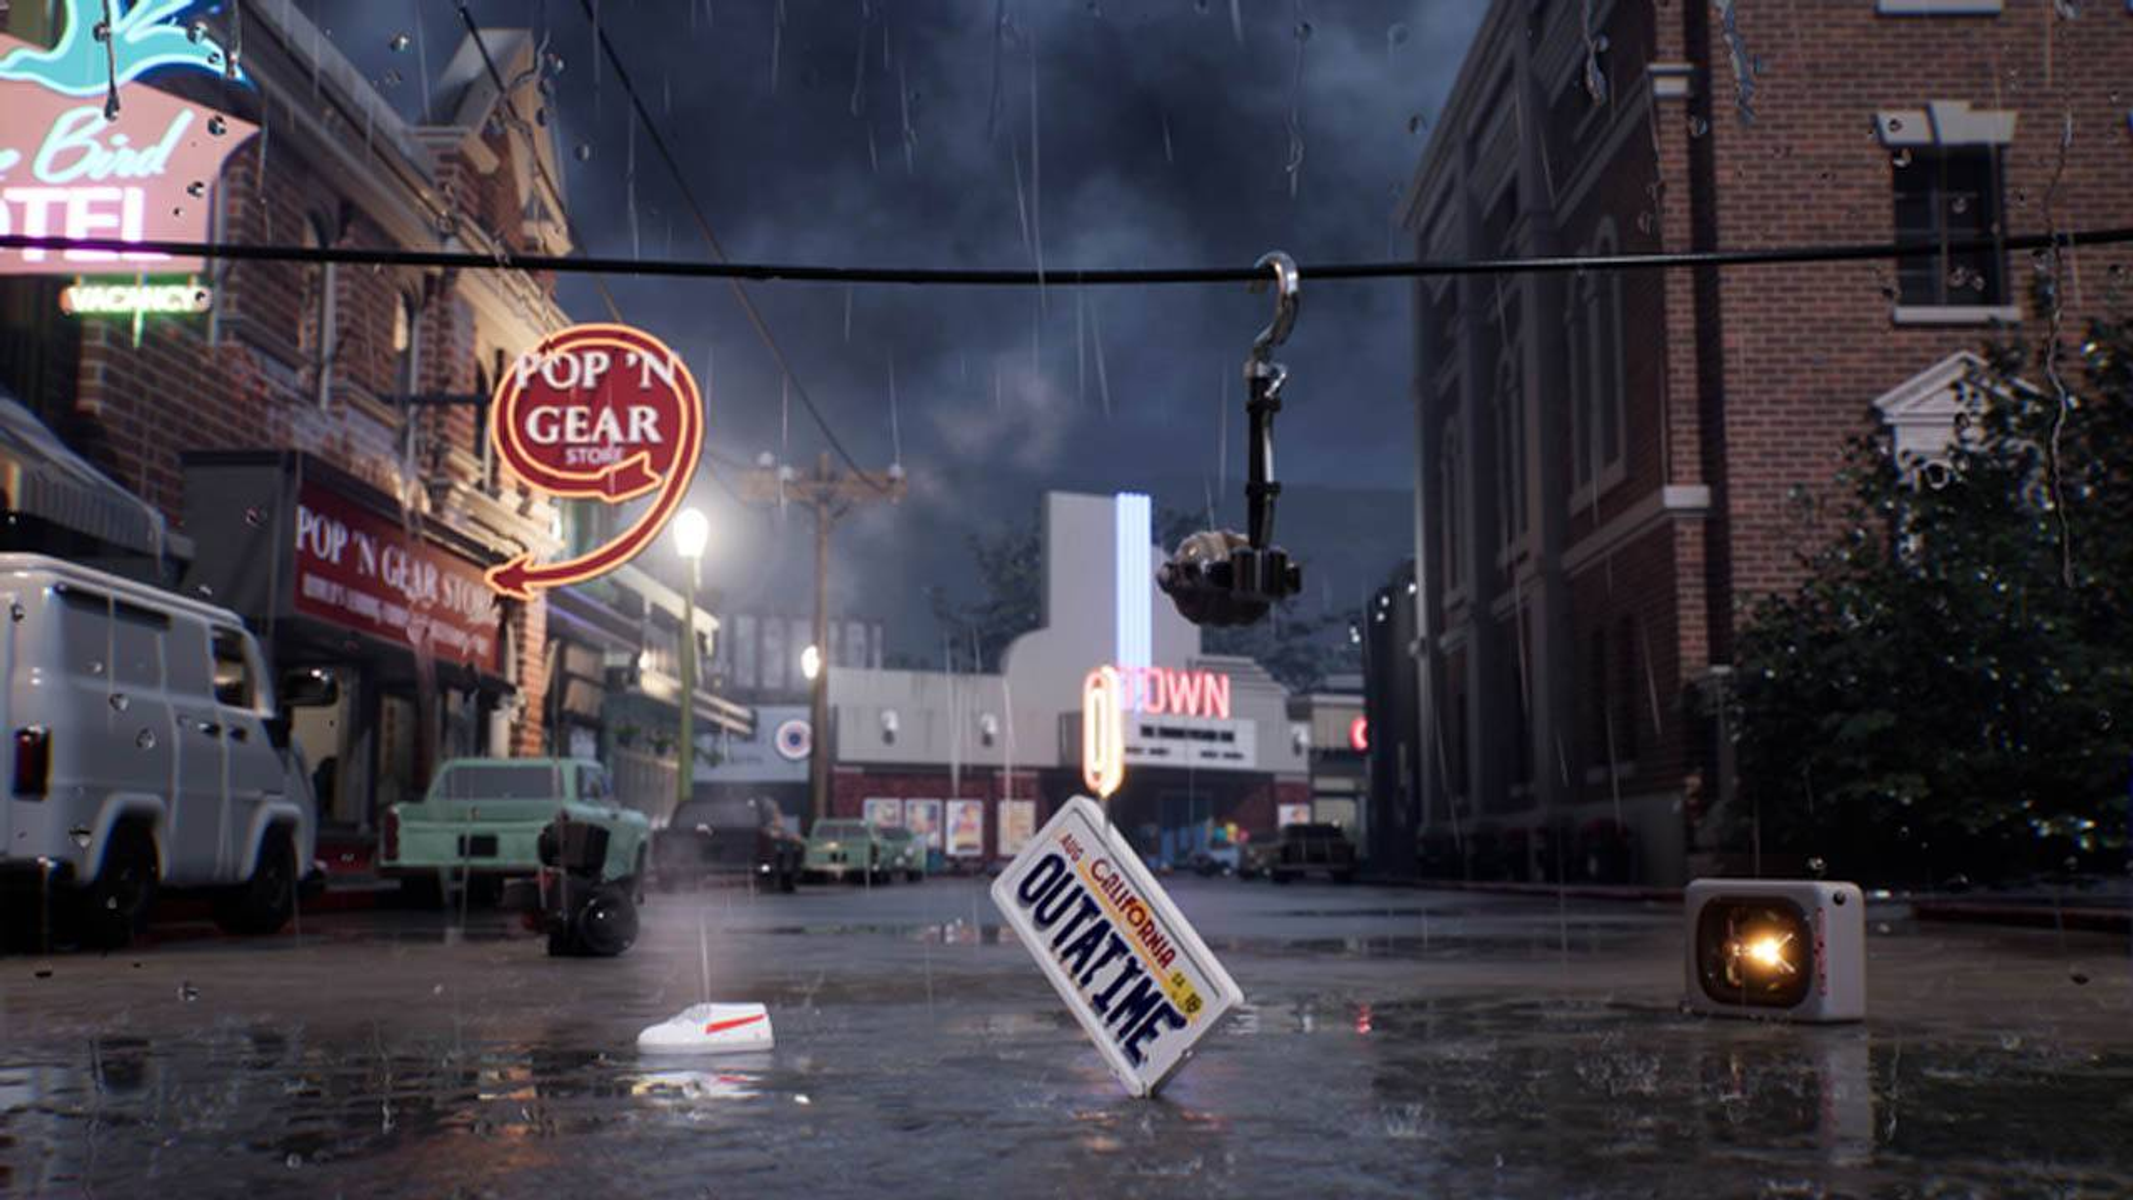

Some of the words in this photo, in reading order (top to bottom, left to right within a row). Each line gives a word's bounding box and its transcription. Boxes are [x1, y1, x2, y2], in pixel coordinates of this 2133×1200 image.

[33, 106, 195, 184] Bird
[0, 186, 171, 262] TEL
[66, 283, 211, 313] VACANCY
[516, 351, 611, 389] POP
[525, 405, 663, 444] GEAR
[565, 447, 623, 465] STORE
[295, 505, 348, 564] POP
[381, 545, 438, 604] GEAR
[1117, 667, 1231, 721] TOWN
[1059, 833, 1085, 863] AUG
[1090, 858, 1177, 970] CALIFORNIA
[1017, 853, 1187, 1068] OUTATIME
